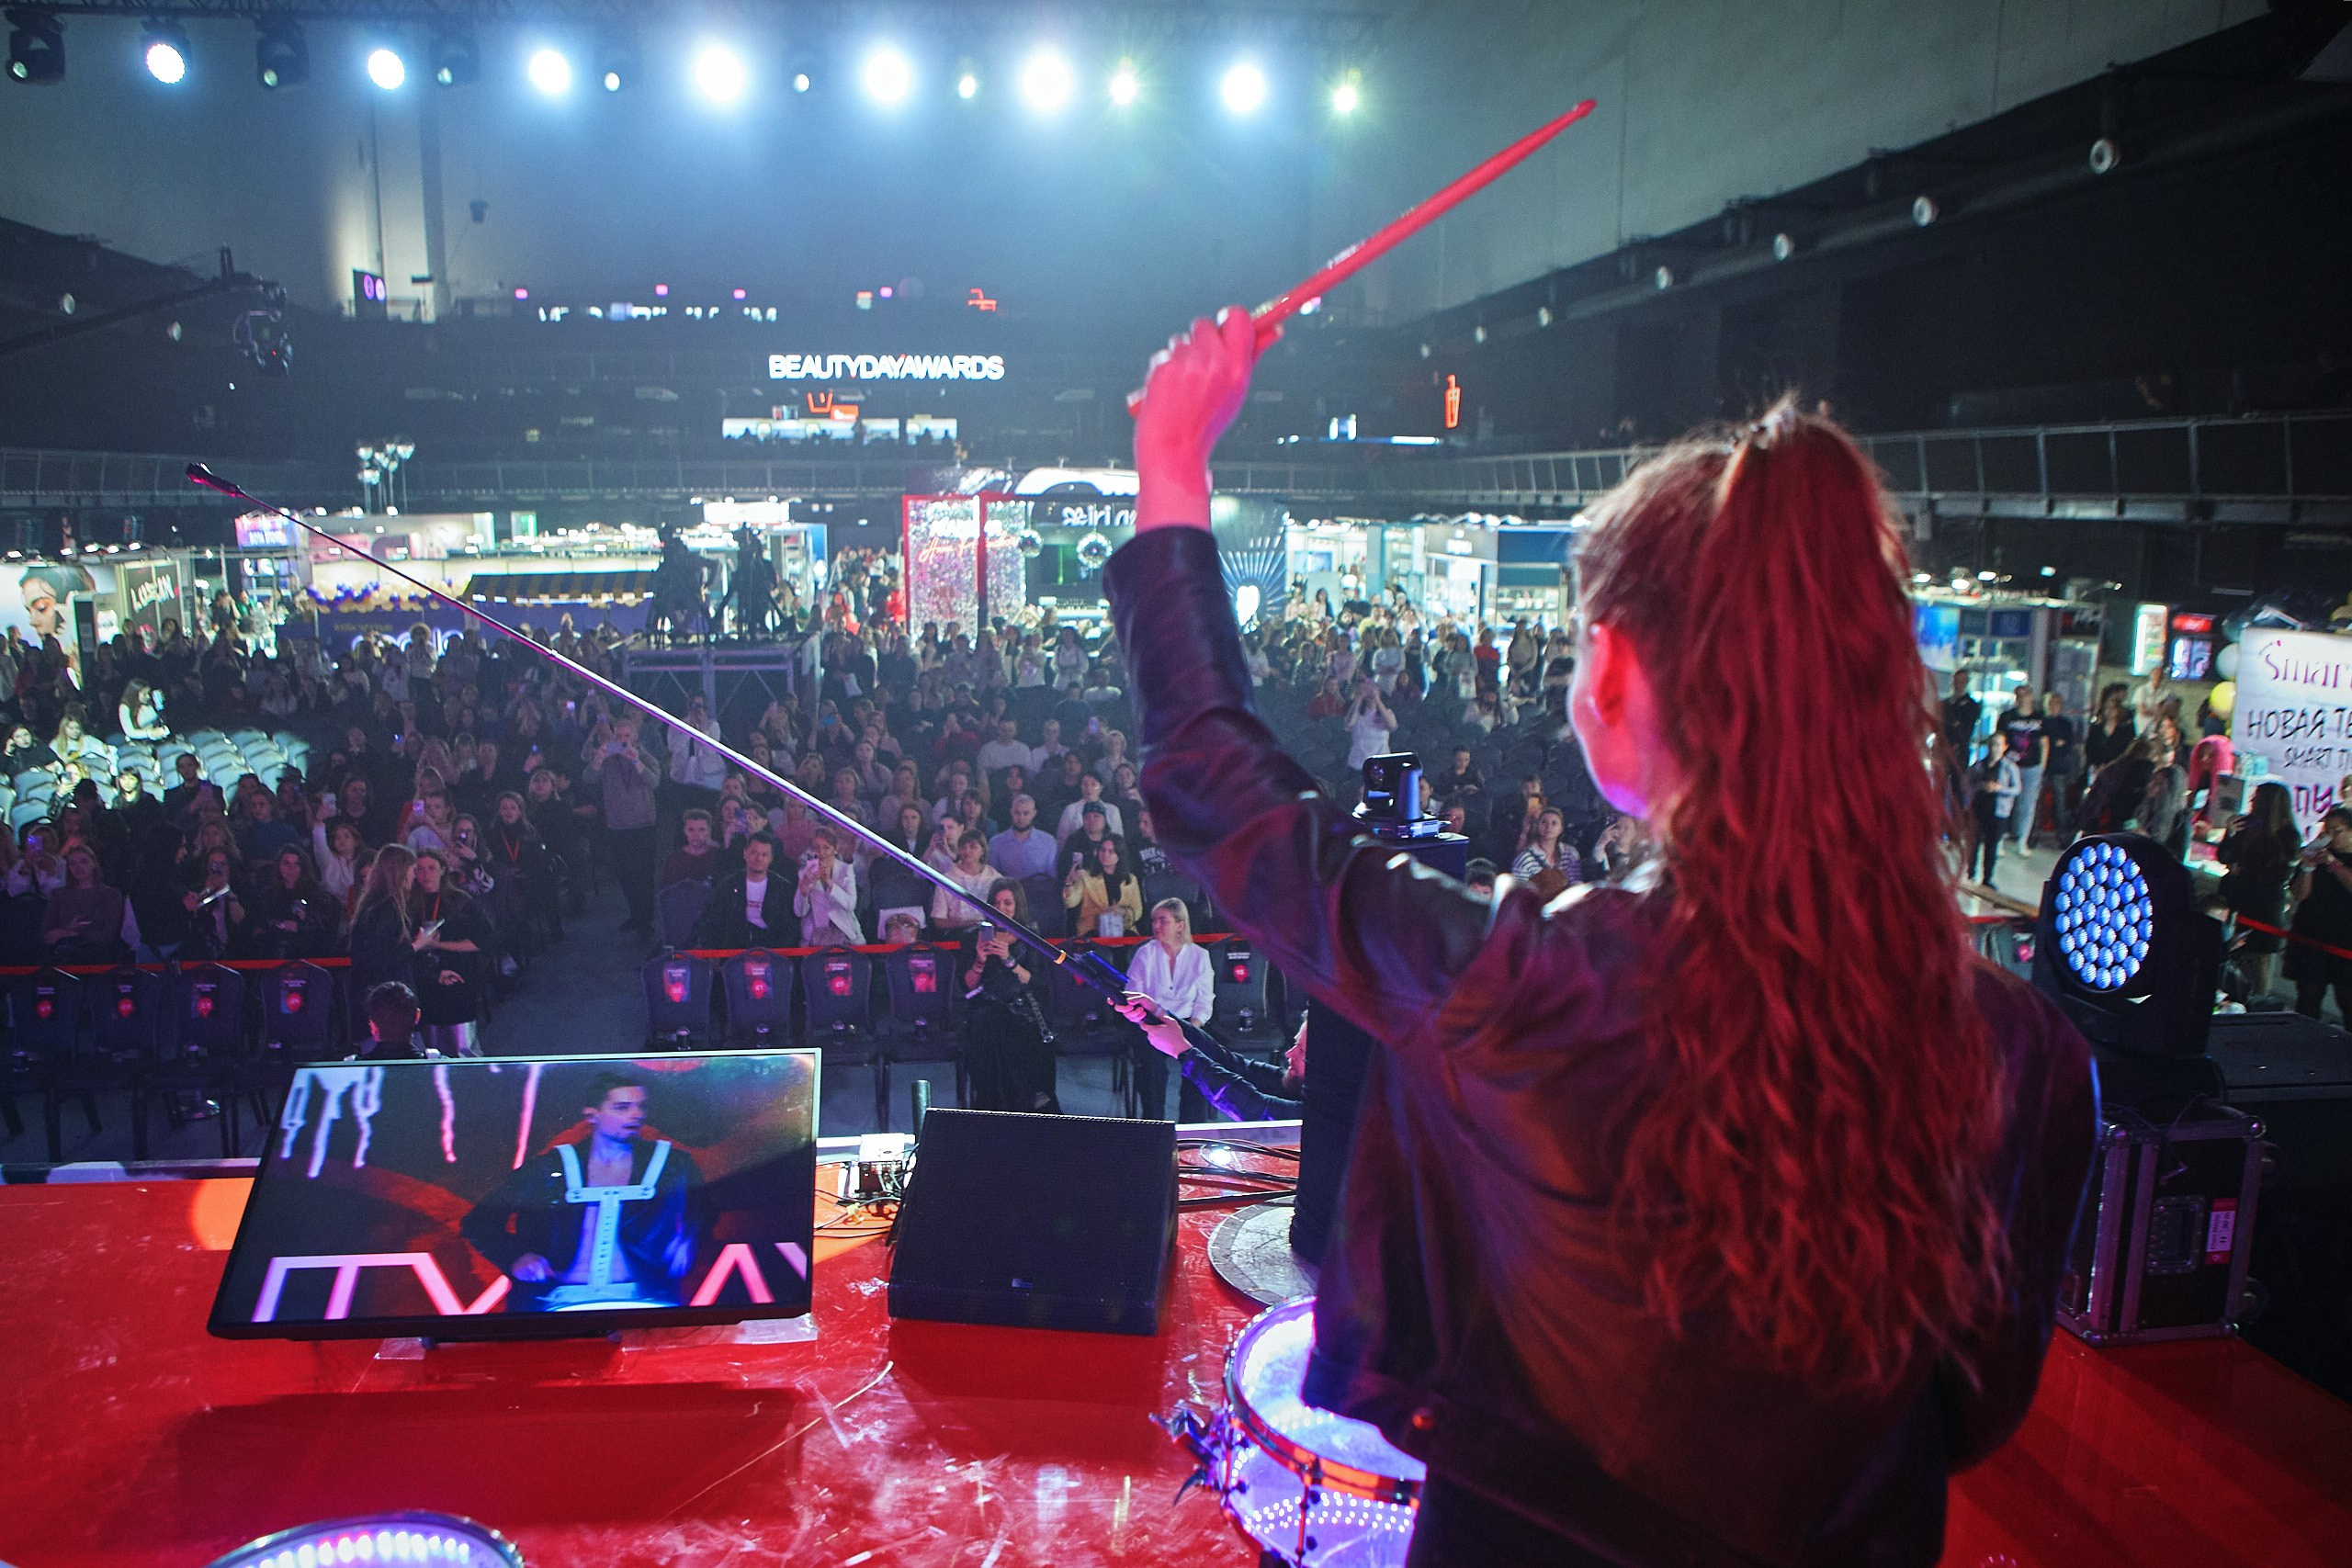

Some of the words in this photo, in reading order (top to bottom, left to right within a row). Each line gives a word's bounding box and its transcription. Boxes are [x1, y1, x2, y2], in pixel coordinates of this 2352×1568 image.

[769, 354, 1006, 380] BEAUTYDAYAWARDS
[2263, 653, 2352, 688] Smar
[2247, 706, 2325, 739] НОВАЯ
